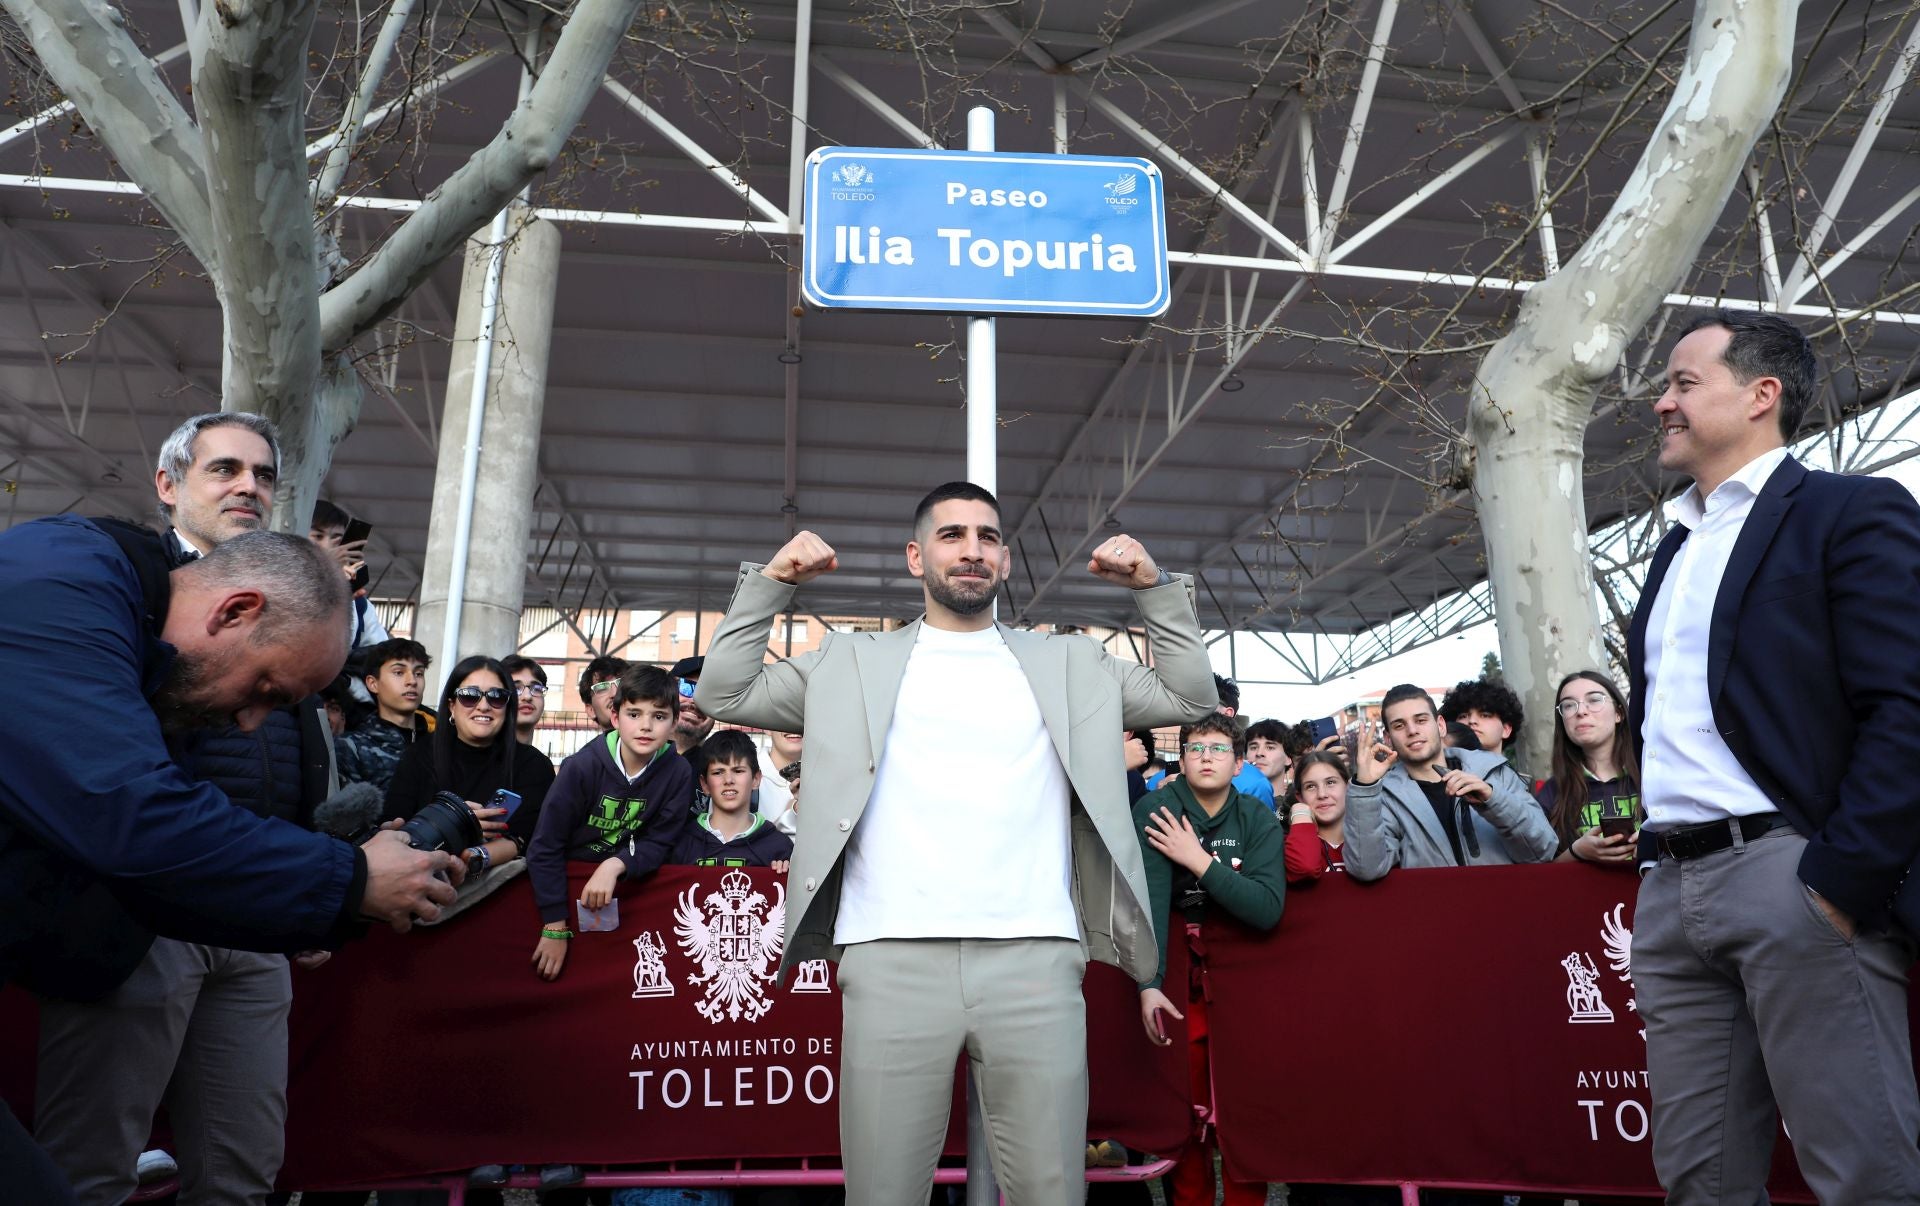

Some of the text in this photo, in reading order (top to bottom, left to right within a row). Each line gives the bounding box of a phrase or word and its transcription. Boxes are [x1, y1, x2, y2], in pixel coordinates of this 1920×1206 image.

[832, 192, 875, 201] TOLEDO
[947, 182, 1048, 208] Paseo
[1104, 197, 1138, 205] TOLEDO
[834, 225, 1137, 277] Ilia Topuria
[1222, 838, 1236, 847] LESS
[631, 1037, 833, 1060] AYUNTAMIENTO DE
[629, 1064, 834, 1110] TOLEDO
